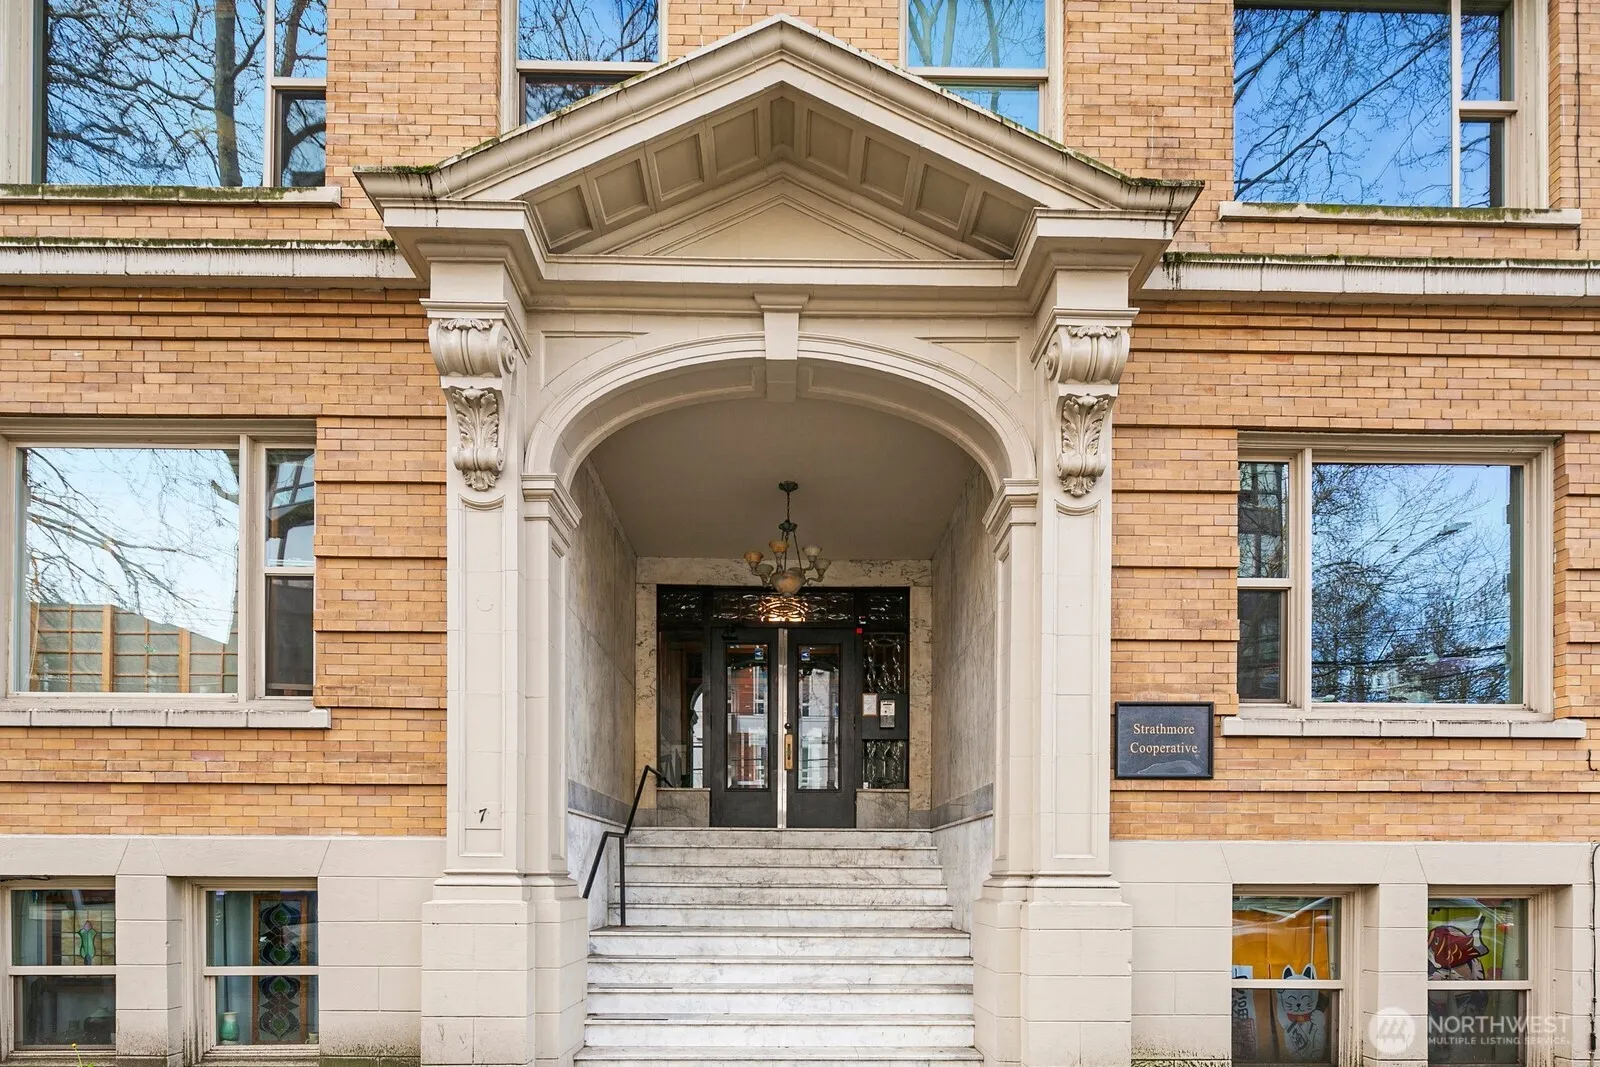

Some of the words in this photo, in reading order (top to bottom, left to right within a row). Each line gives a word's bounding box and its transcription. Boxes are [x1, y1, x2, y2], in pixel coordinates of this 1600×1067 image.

[1133, 723, 1195, 735] Strathmore
[1130, 742, 1198, 756] Cooperative
[479, 808, 488, 823] 7
